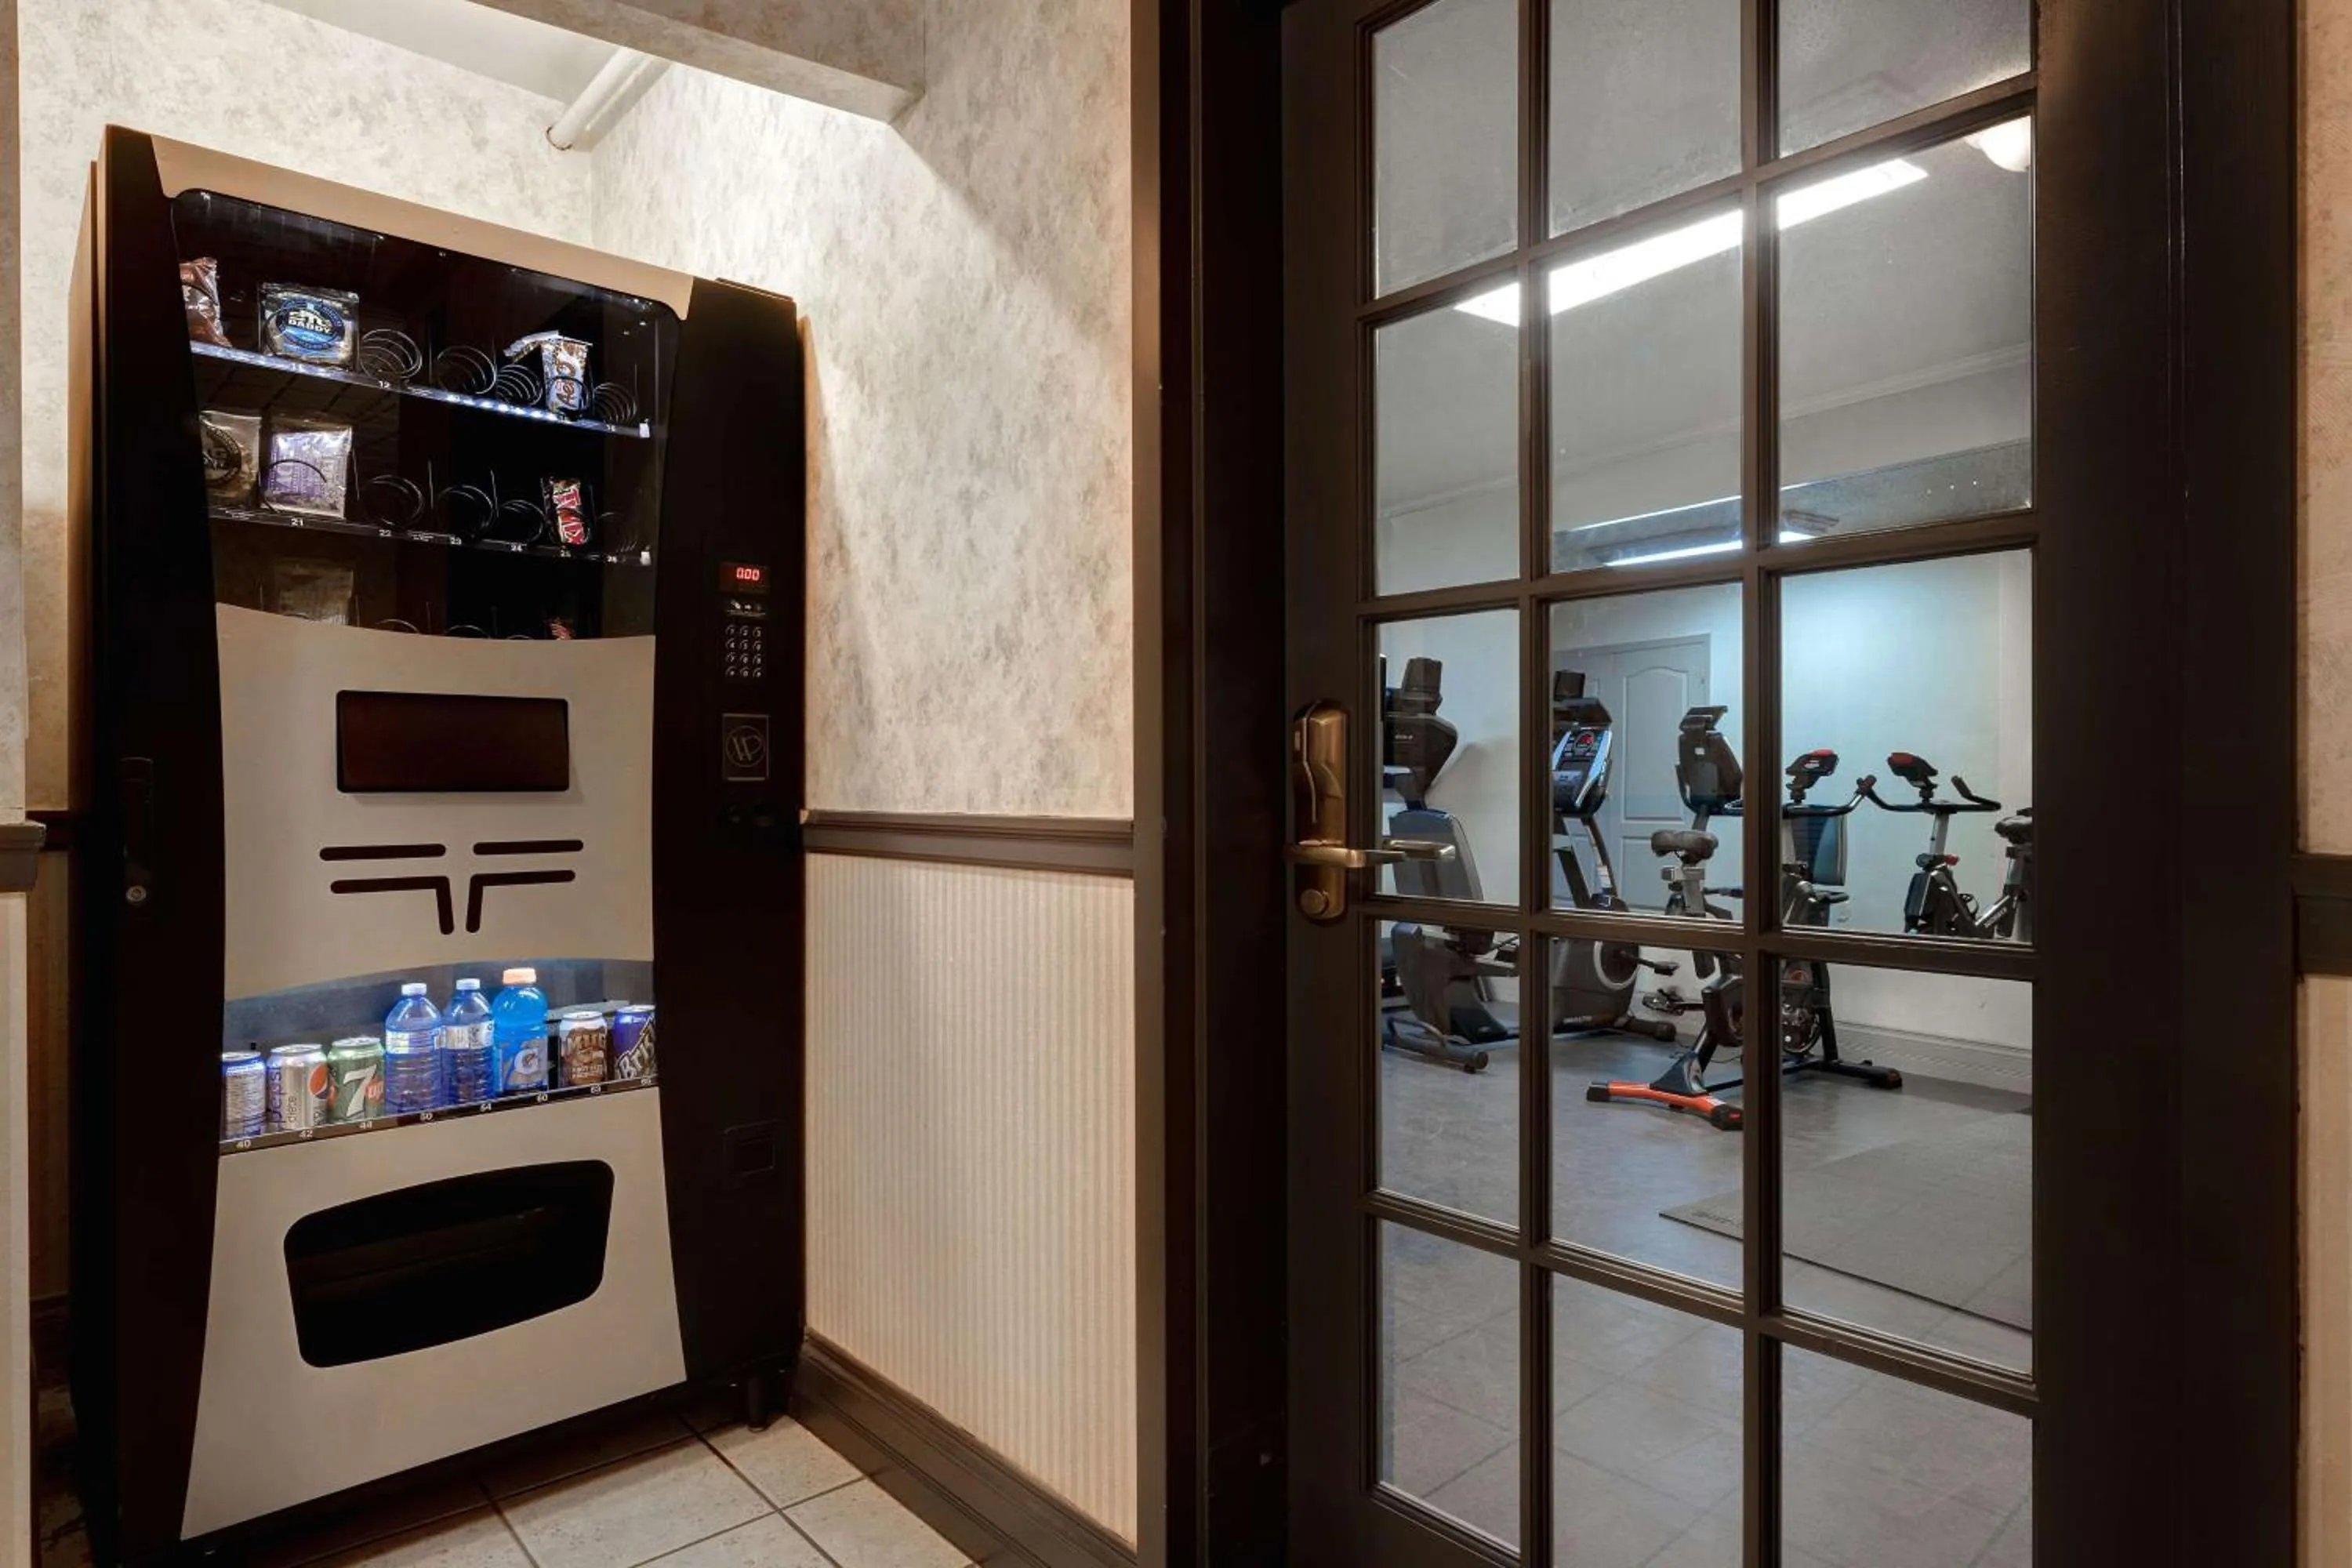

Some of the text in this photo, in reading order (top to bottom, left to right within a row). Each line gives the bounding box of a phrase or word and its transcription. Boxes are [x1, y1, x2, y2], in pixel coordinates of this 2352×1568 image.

[288, 319, 332, 333] DADDY
[291, 517, 303, 526] 21
[511, 543, 522, 552] 24
[236, 1139, 252, 1149] 40
[299, 1130, 313, 1138] 42
